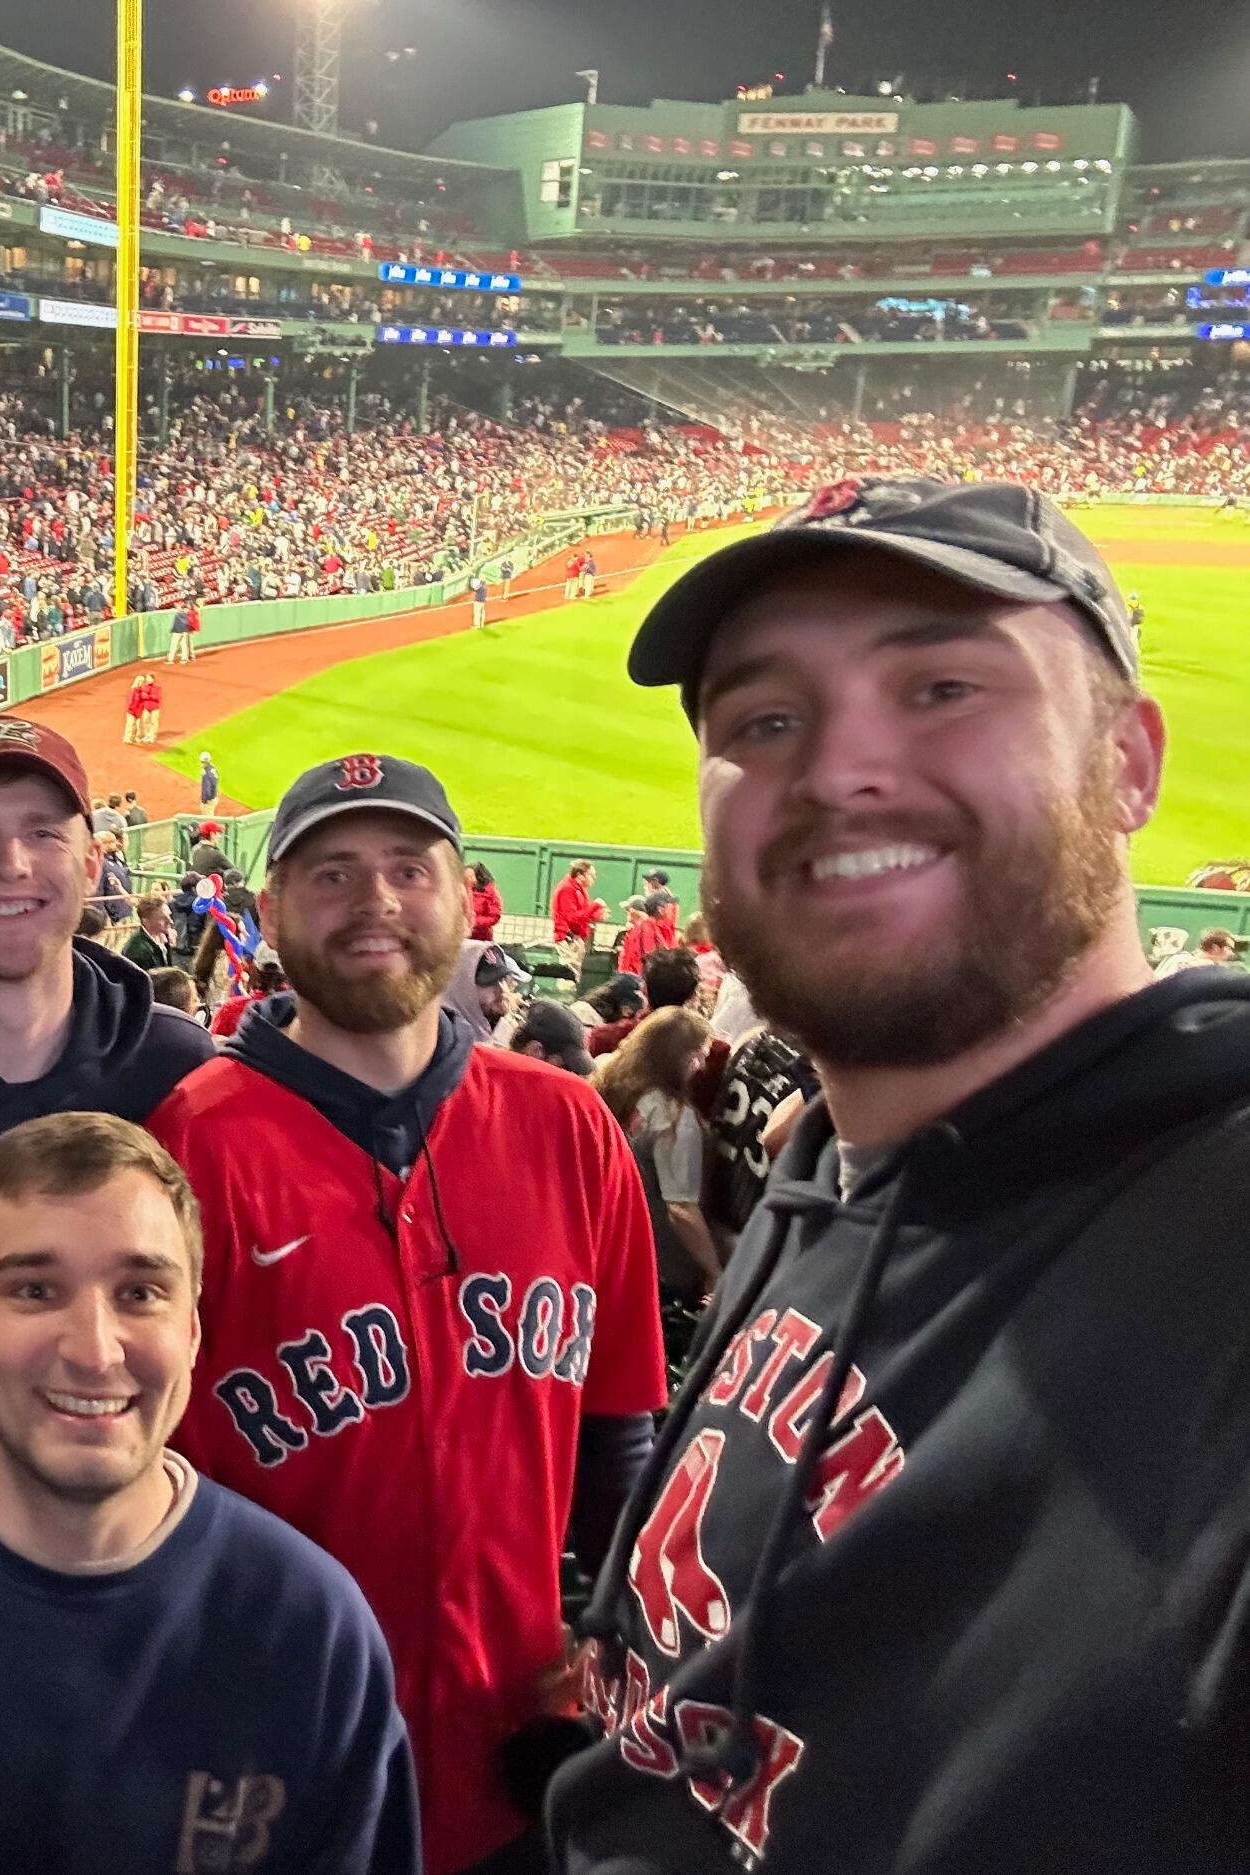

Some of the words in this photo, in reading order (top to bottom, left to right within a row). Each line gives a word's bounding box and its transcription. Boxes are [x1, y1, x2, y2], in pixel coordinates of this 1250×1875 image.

[749, 116, 824, 129] FENWAY
[835, 116, 886, 129] PARK
[62, 644, 93, 679] KAYEM
[333, 753, 385, 792] B
[214, 1302, 412, 1469] RED
